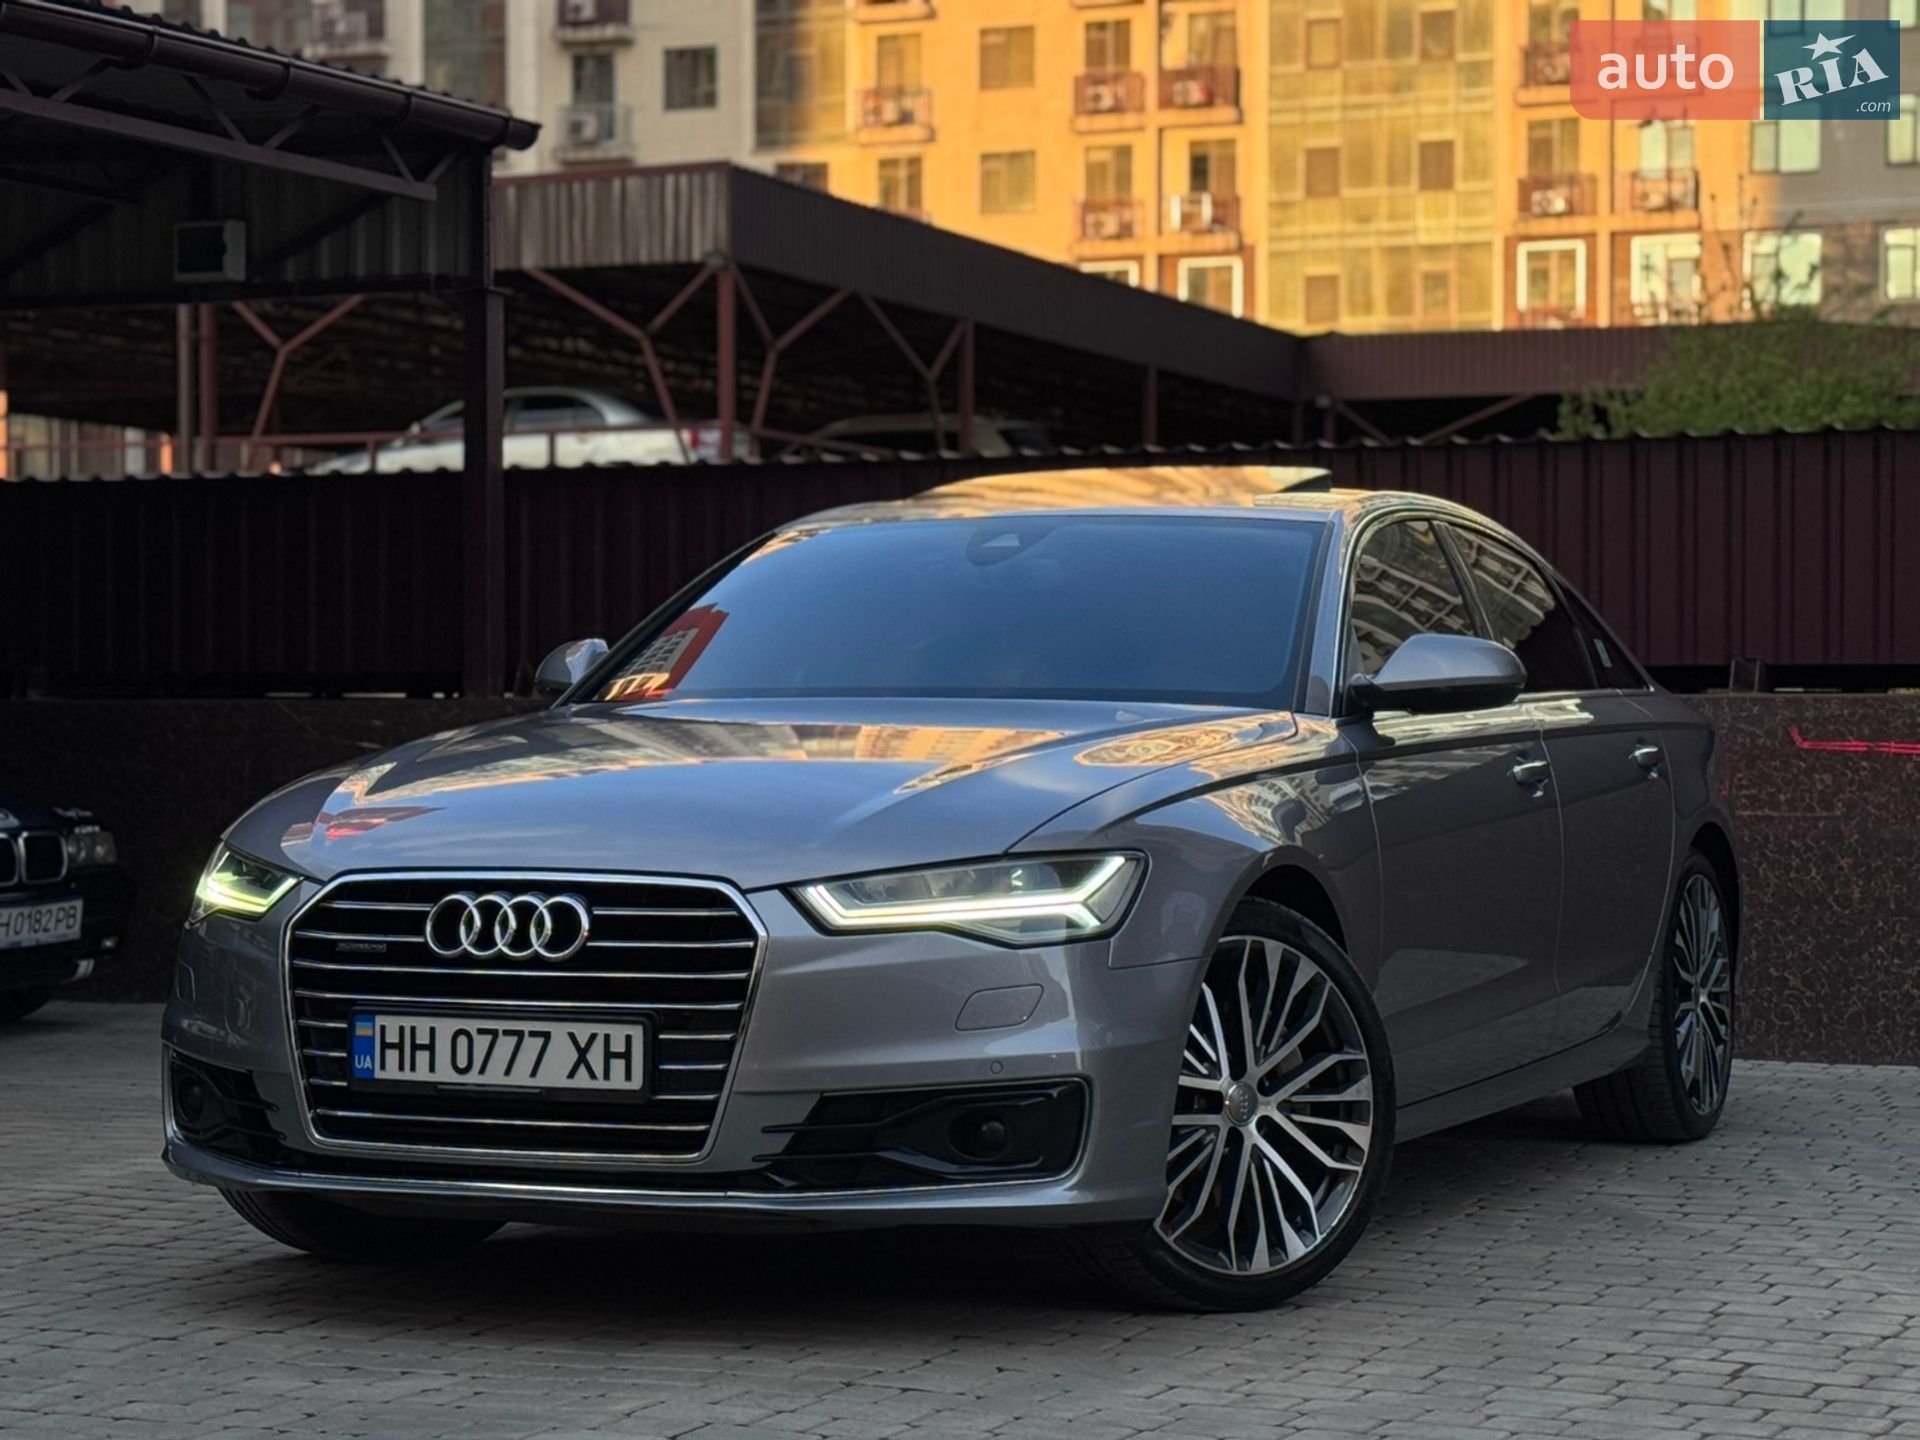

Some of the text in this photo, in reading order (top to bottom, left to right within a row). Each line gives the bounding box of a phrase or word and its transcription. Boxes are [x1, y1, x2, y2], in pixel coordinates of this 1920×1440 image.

[355, 1055, 373, 1070] UA
[379, 1024, 633, 1082] HH 0777 XH
